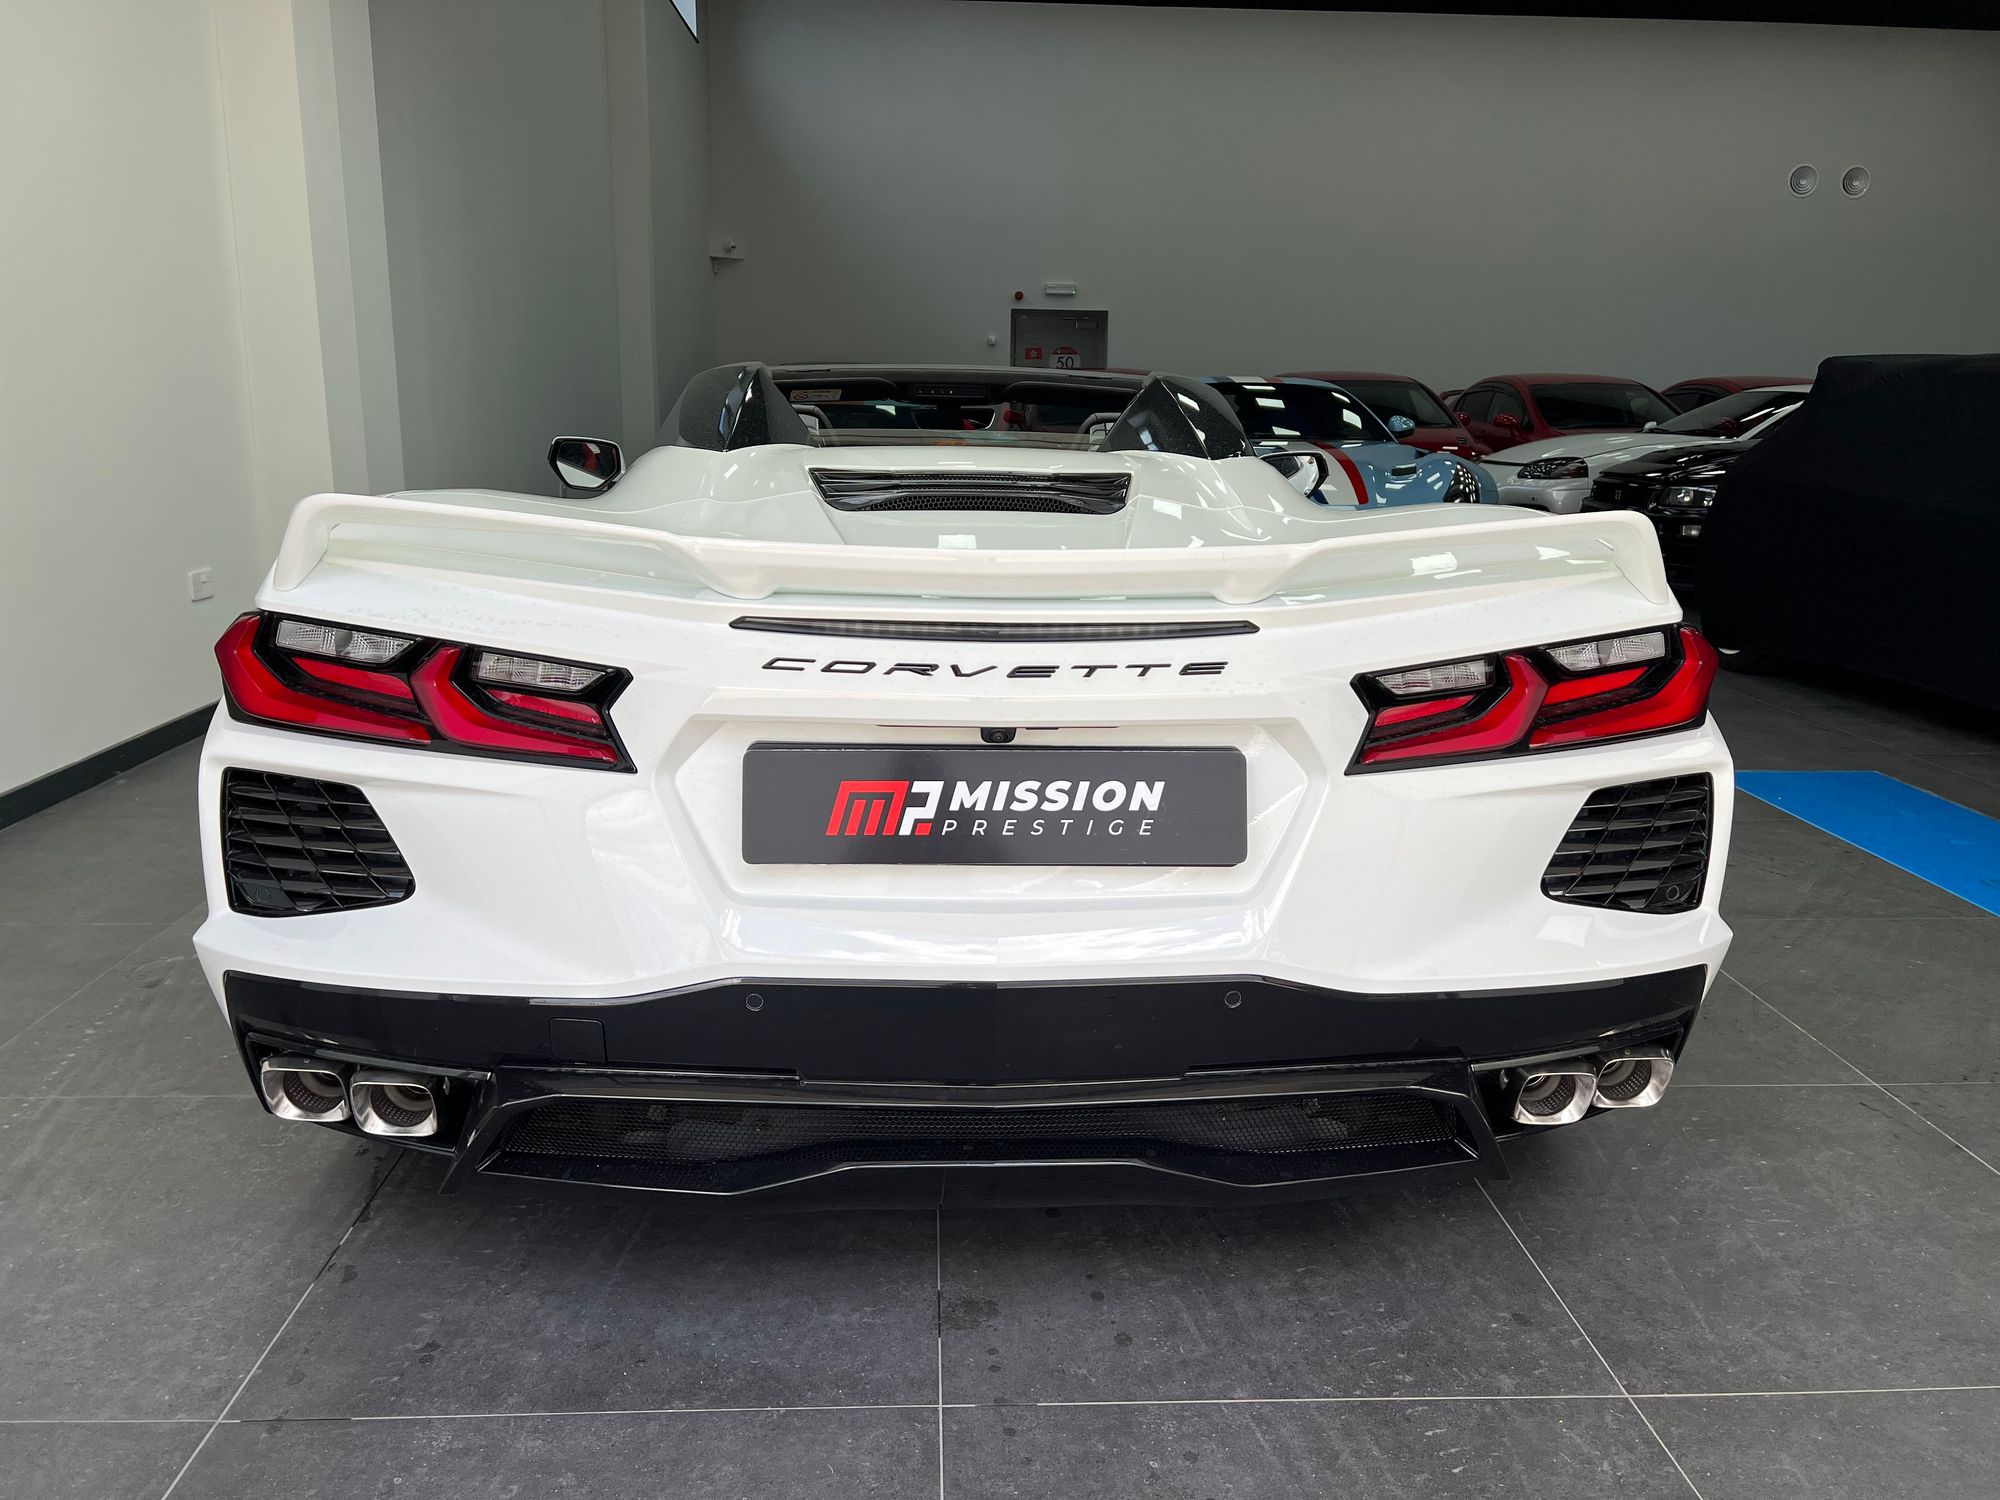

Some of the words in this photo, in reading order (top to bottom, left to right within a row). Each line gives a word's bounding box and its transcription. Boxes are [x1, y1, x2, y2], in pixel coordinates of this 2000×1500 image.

[1056, 356, 1074, 370] 50
[761, 656, 1229, 679] CORVETTE
[948, 780, 1165, 812] MISSION
[941, 819, 1154, 836] PRESTIGE
